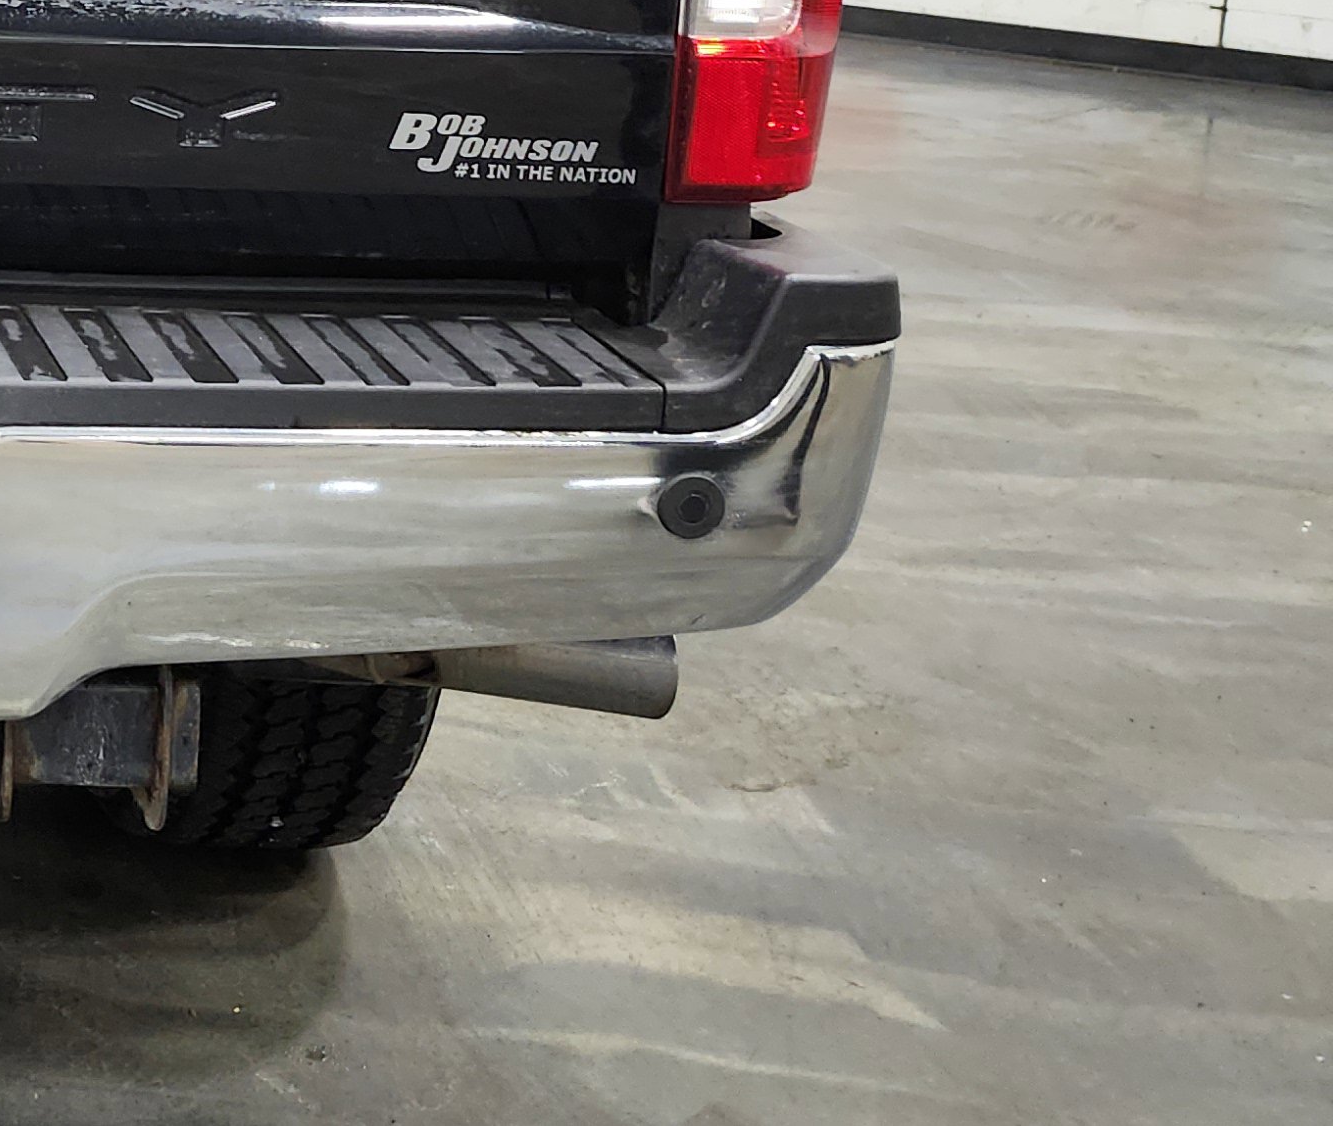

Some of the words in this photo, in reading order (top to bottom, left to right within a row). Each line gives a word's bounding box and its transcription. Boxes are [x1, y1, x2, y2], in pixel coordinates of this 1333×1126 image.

[389, 112, 486, 151] BOB
[416, 135, 600, 173] JOHNSON
[454, 162, 481, 179] #1
[485, 163, 512, 180] IN
[516, 165, 553, 182] THE
[559, 166, 637, 185] NATION
